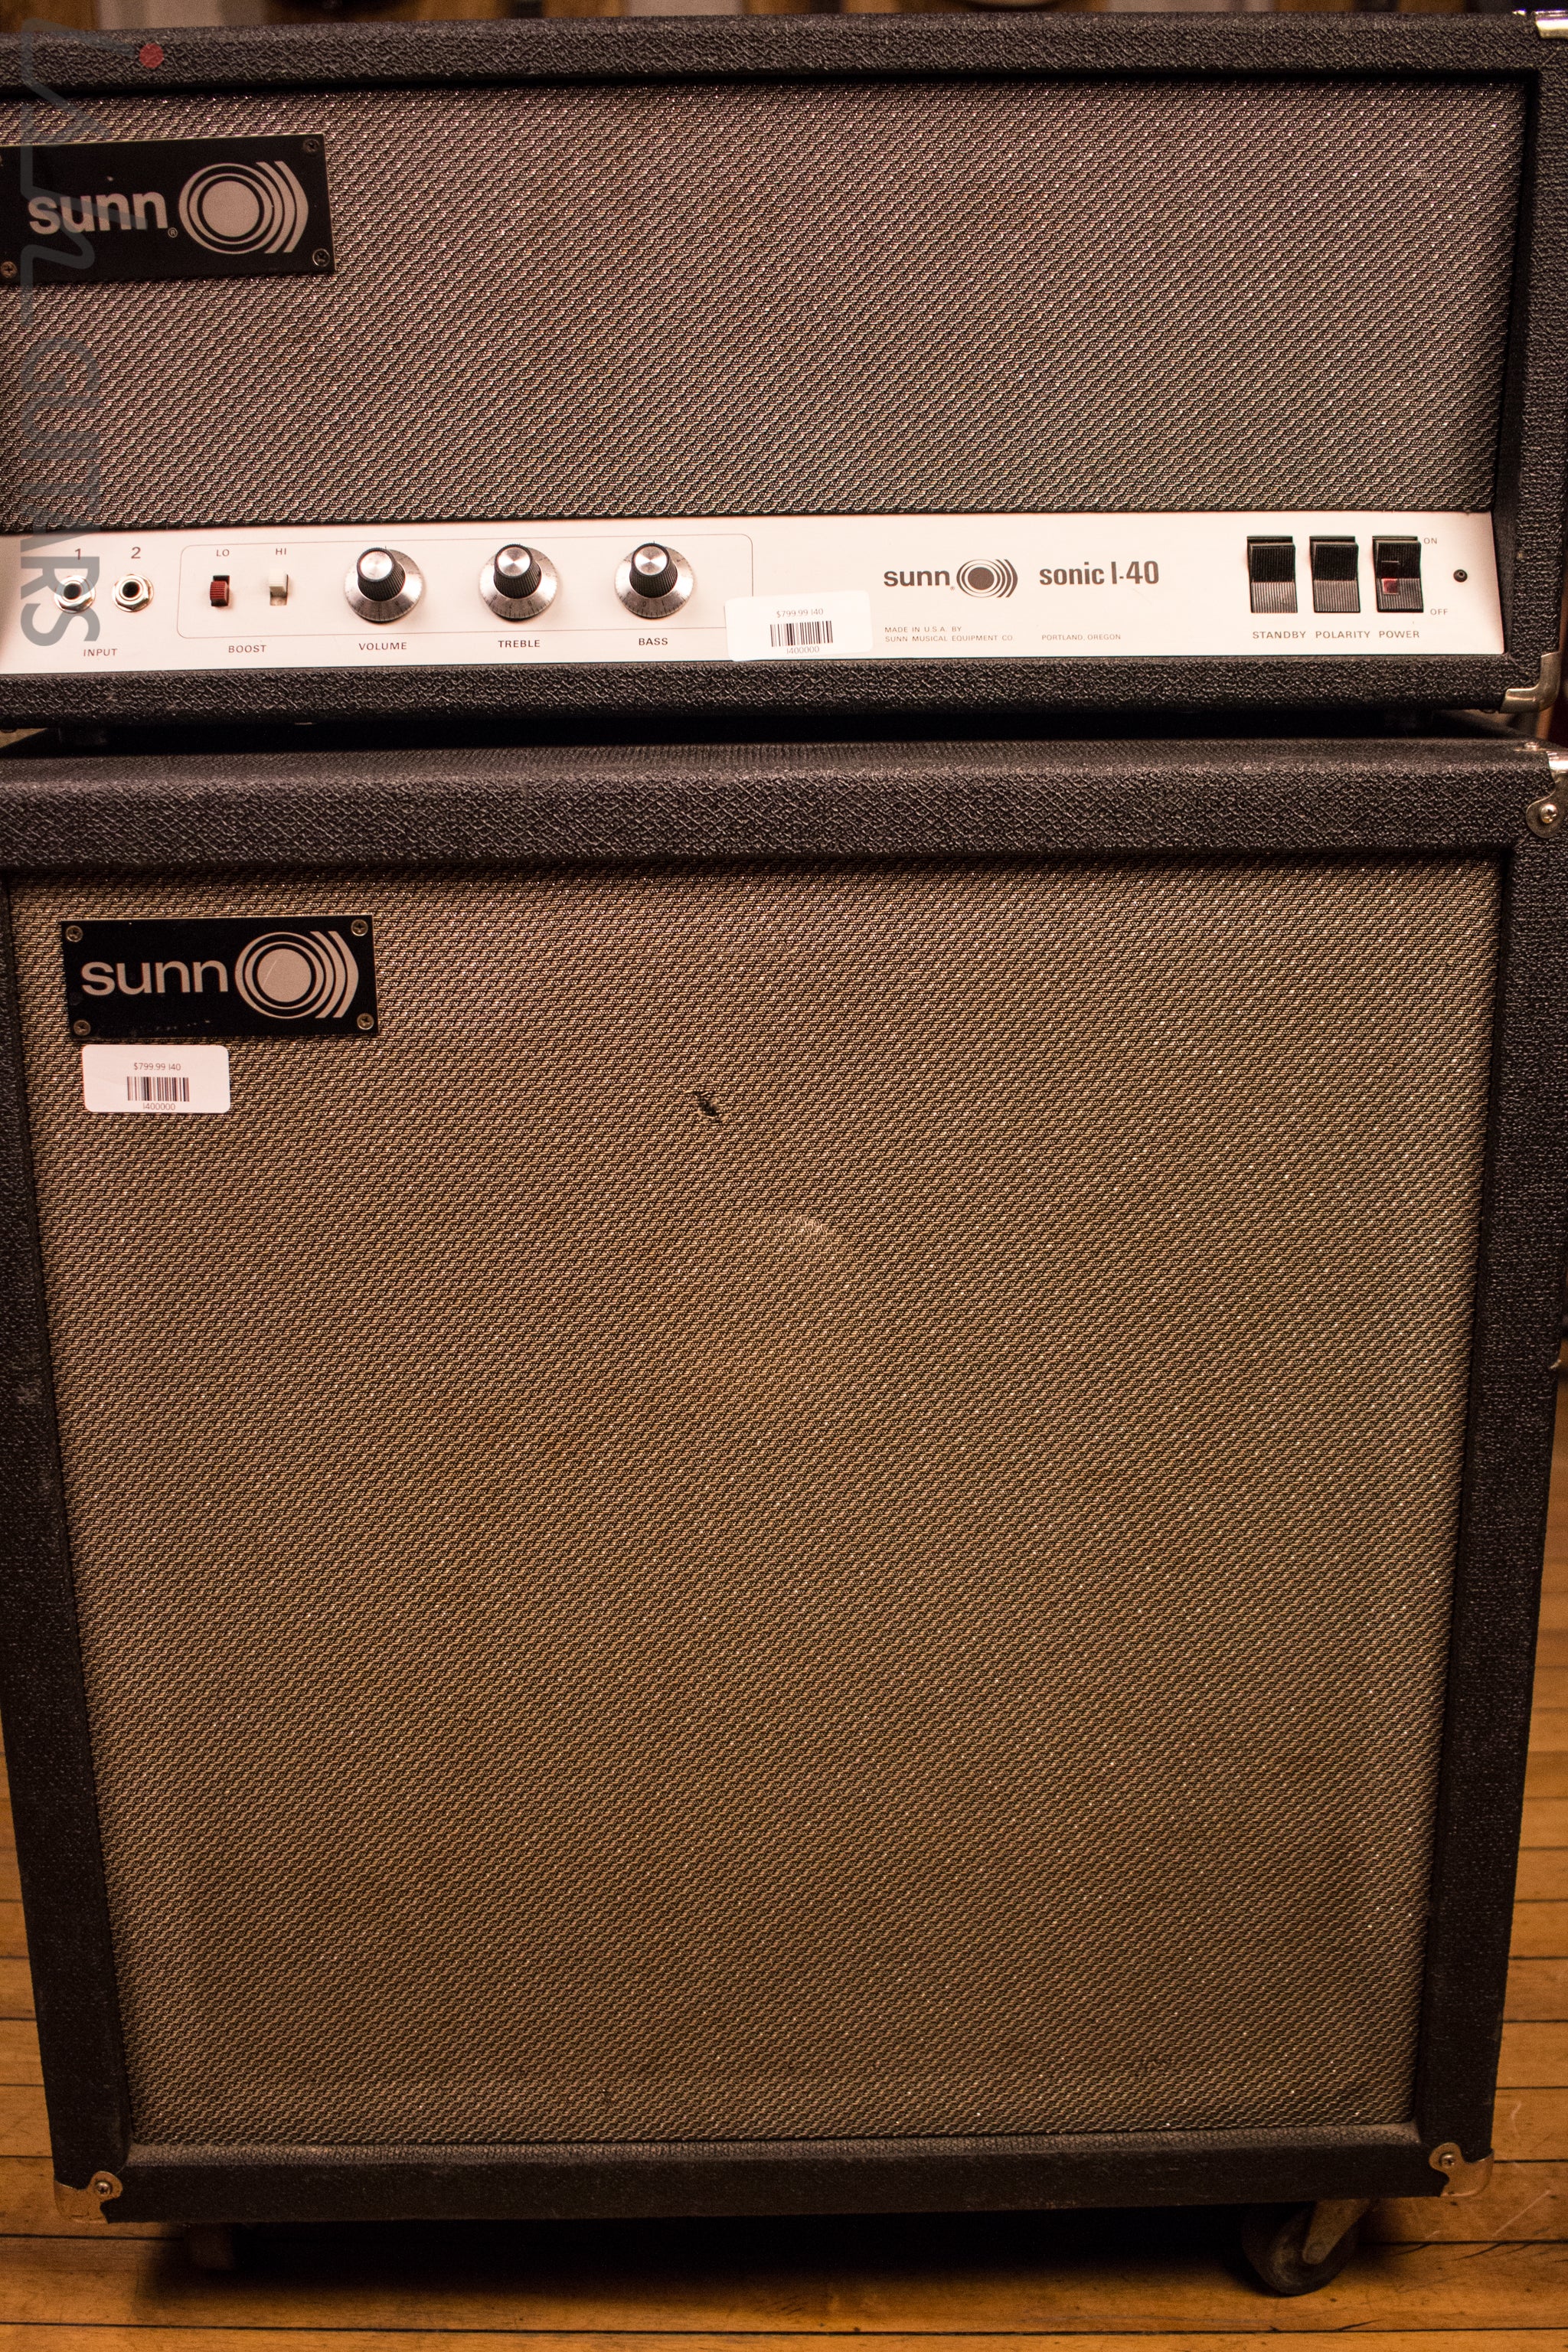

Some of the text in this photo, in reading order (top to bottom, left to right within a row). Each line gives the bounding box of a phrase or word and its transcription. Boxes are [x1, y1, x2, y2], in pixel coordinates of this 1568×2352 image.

[28, 191, 168, 234] sunn
[74, 547, 82, 560] 1
[131, 547, 141, 559] 2
[216, 549, 230, 557] LO
[275, 547, 287, 556] HI
[884, 569, 950, 587] sunn
[1039, 561, 1105, 586] sonic
[1252, 631, 1306, 639] STANDBY
[498, 639, 541, 648] TREBLE
[639, 637, 668, 646] BASS
[228, 645, 266, 654] BOOST
[358, 642, 407, 651] VOLUME
[83, 648, 118, 657] INPUT
[81, 960, 228, 996] sunn
[133, 1062, 166, 1071] $799.99
